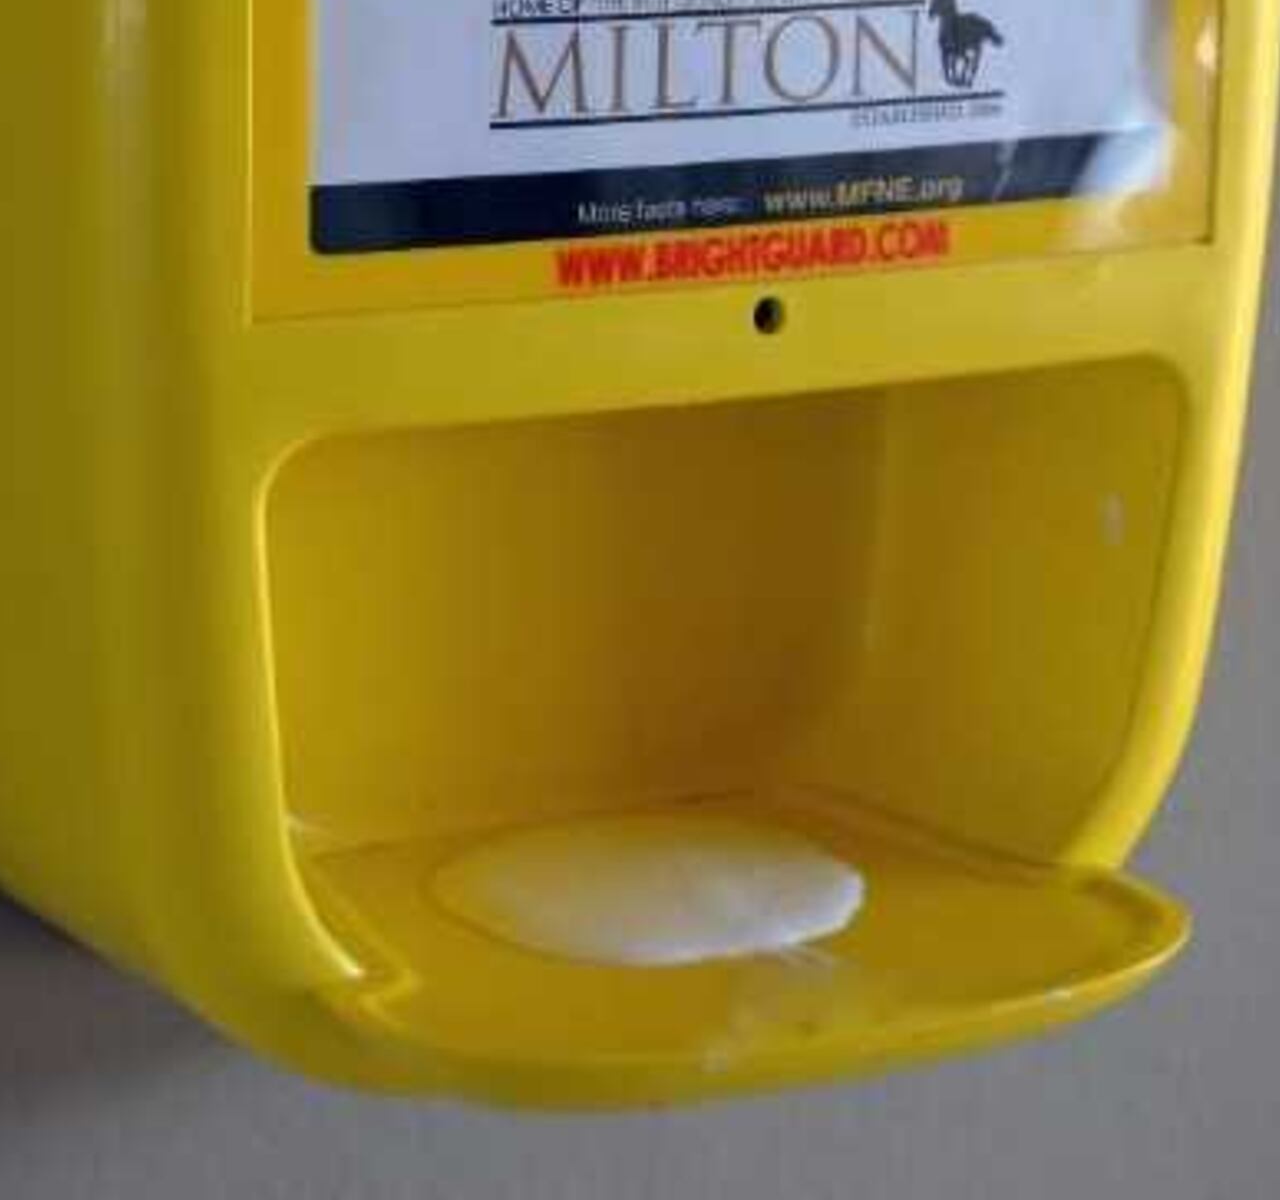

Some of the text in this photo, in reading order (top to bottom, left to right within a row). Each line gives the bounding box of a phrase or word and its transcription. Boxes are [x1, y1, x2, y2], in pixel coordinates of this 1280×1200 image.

[496, 7, 925, 119] MILTON
[765, 177, 964, 213] www.MFNE.org
[556, 220, 951, 287] WWW.BRIGHTGUARD.COM
